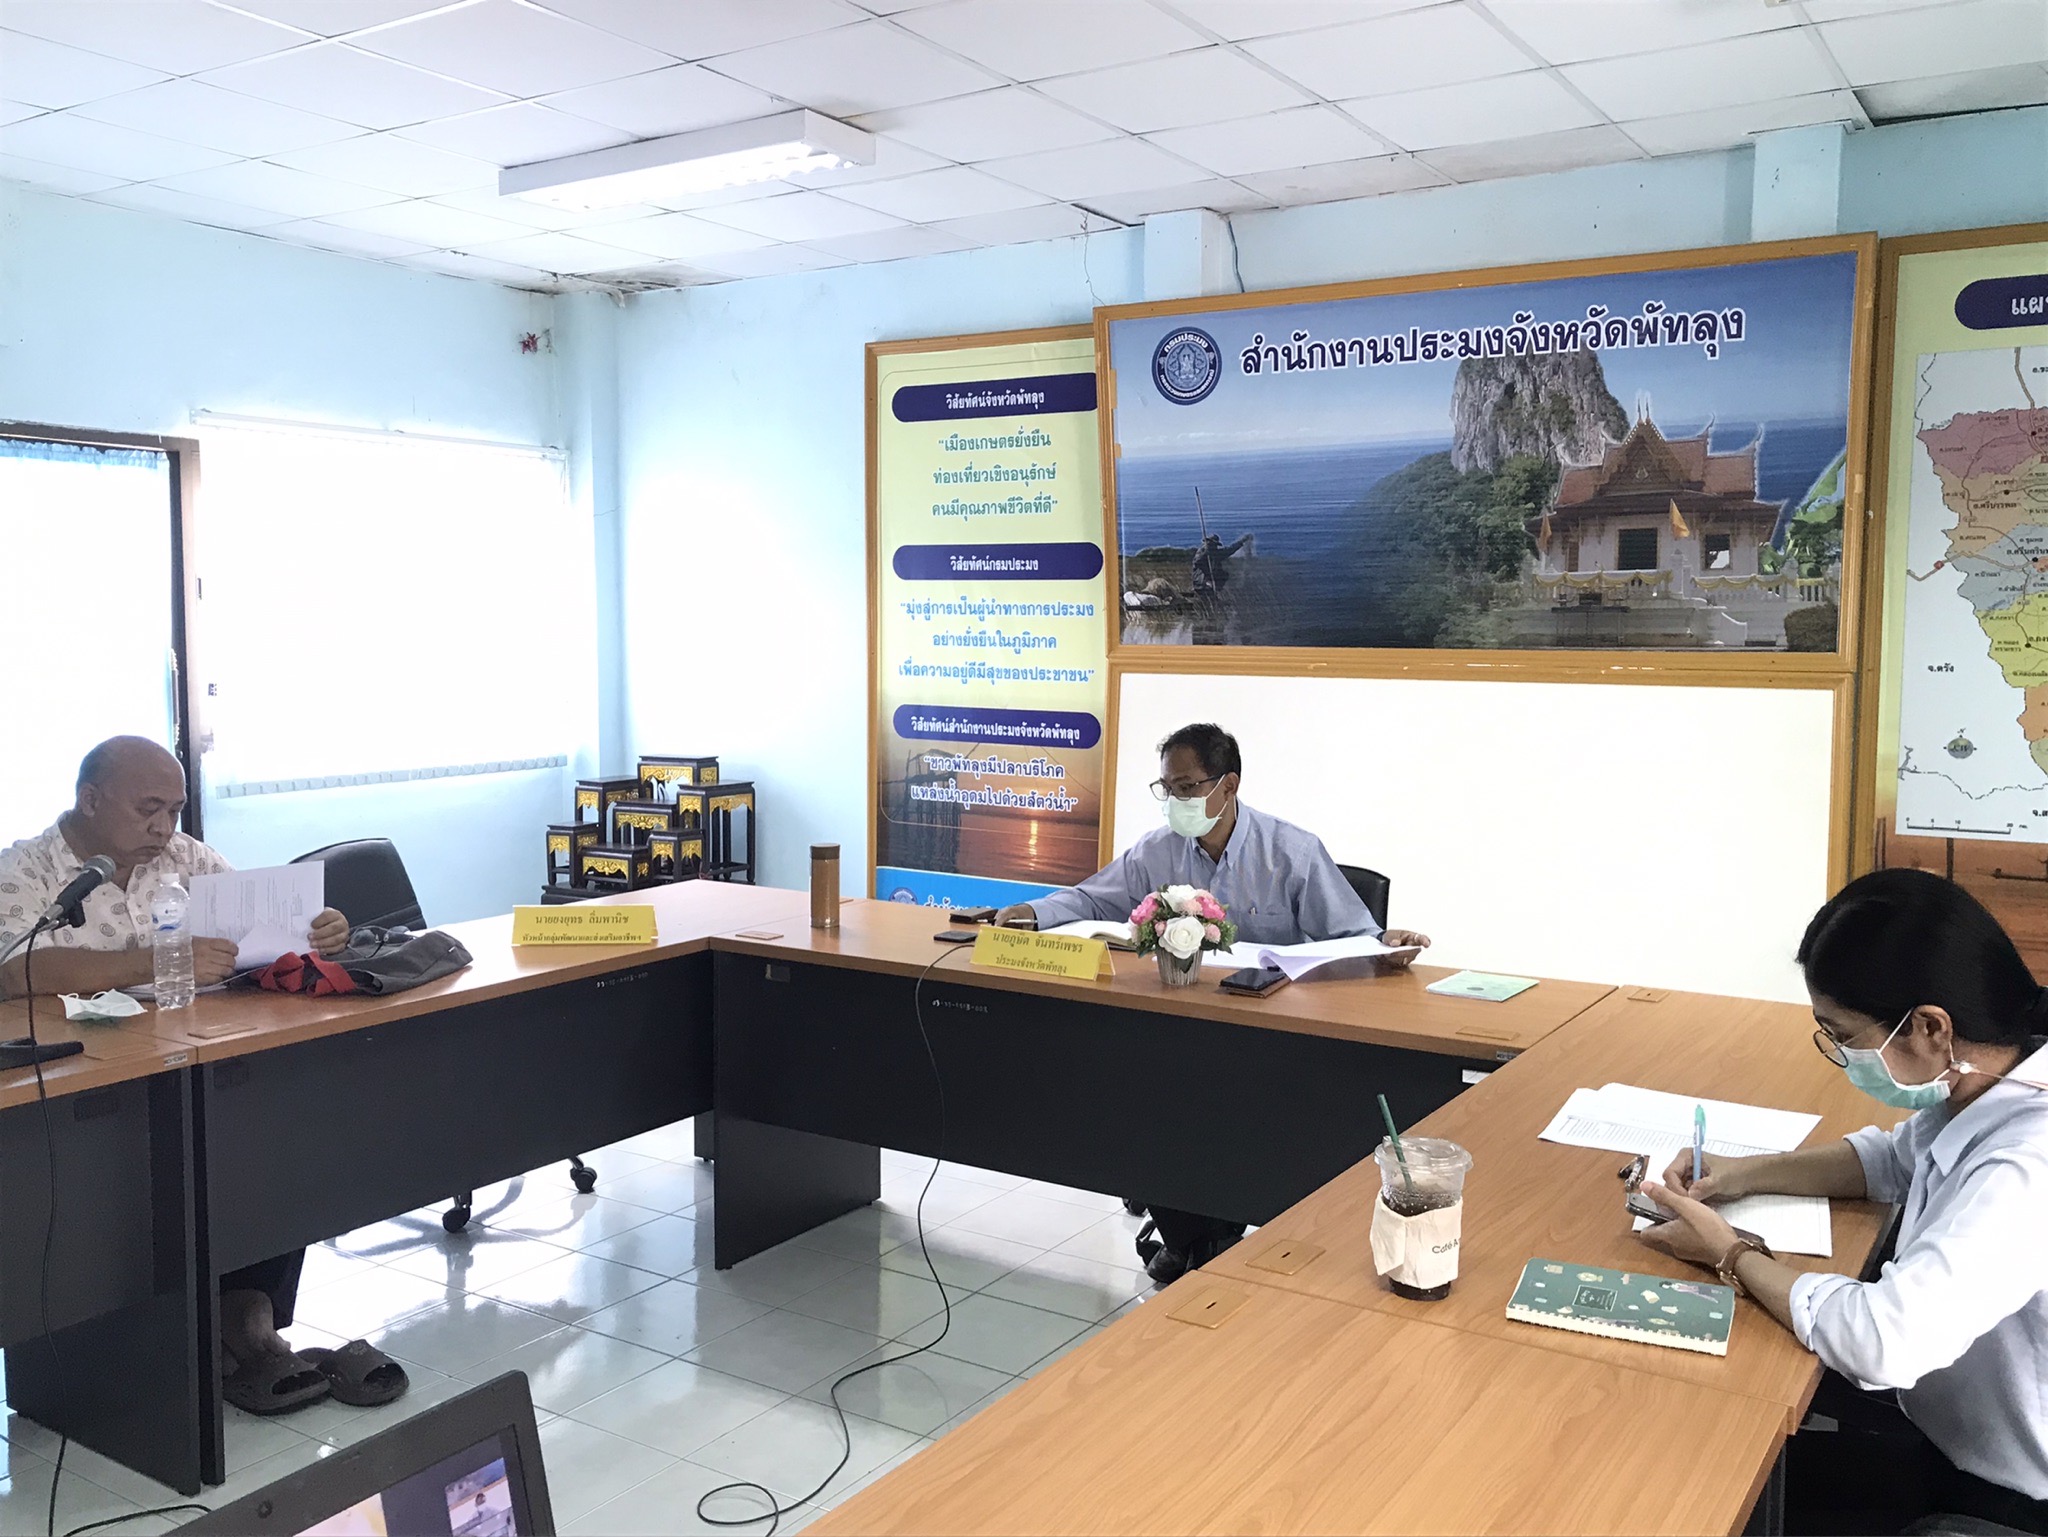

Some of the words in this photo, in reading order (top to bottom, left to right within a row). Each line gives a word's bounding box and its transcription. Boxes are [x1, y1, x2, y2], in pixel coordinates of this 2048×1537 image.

[1164, 333, 1208, 353] กรมประมง
[1240, 302, 1745, 375] สำนักงานประมงจังหวัดพัทลุง
[946, 388, 1045, 410] วิสัยทัศน์จังหวัดพัทลุง
[933, 460, 1056, 487] ท่องเที่ยวเชิงอนุรักษ์
[950, 555, 1039, 571] วิสัยทัศน์กรมประมง
[933, 626, 1057, 654] อย่างยั่งยืนในภูมิภาค
[911, 716, 1080, 745] วิสัยทัศน์สำนักงานประมงจังหวัดพัทลุง
